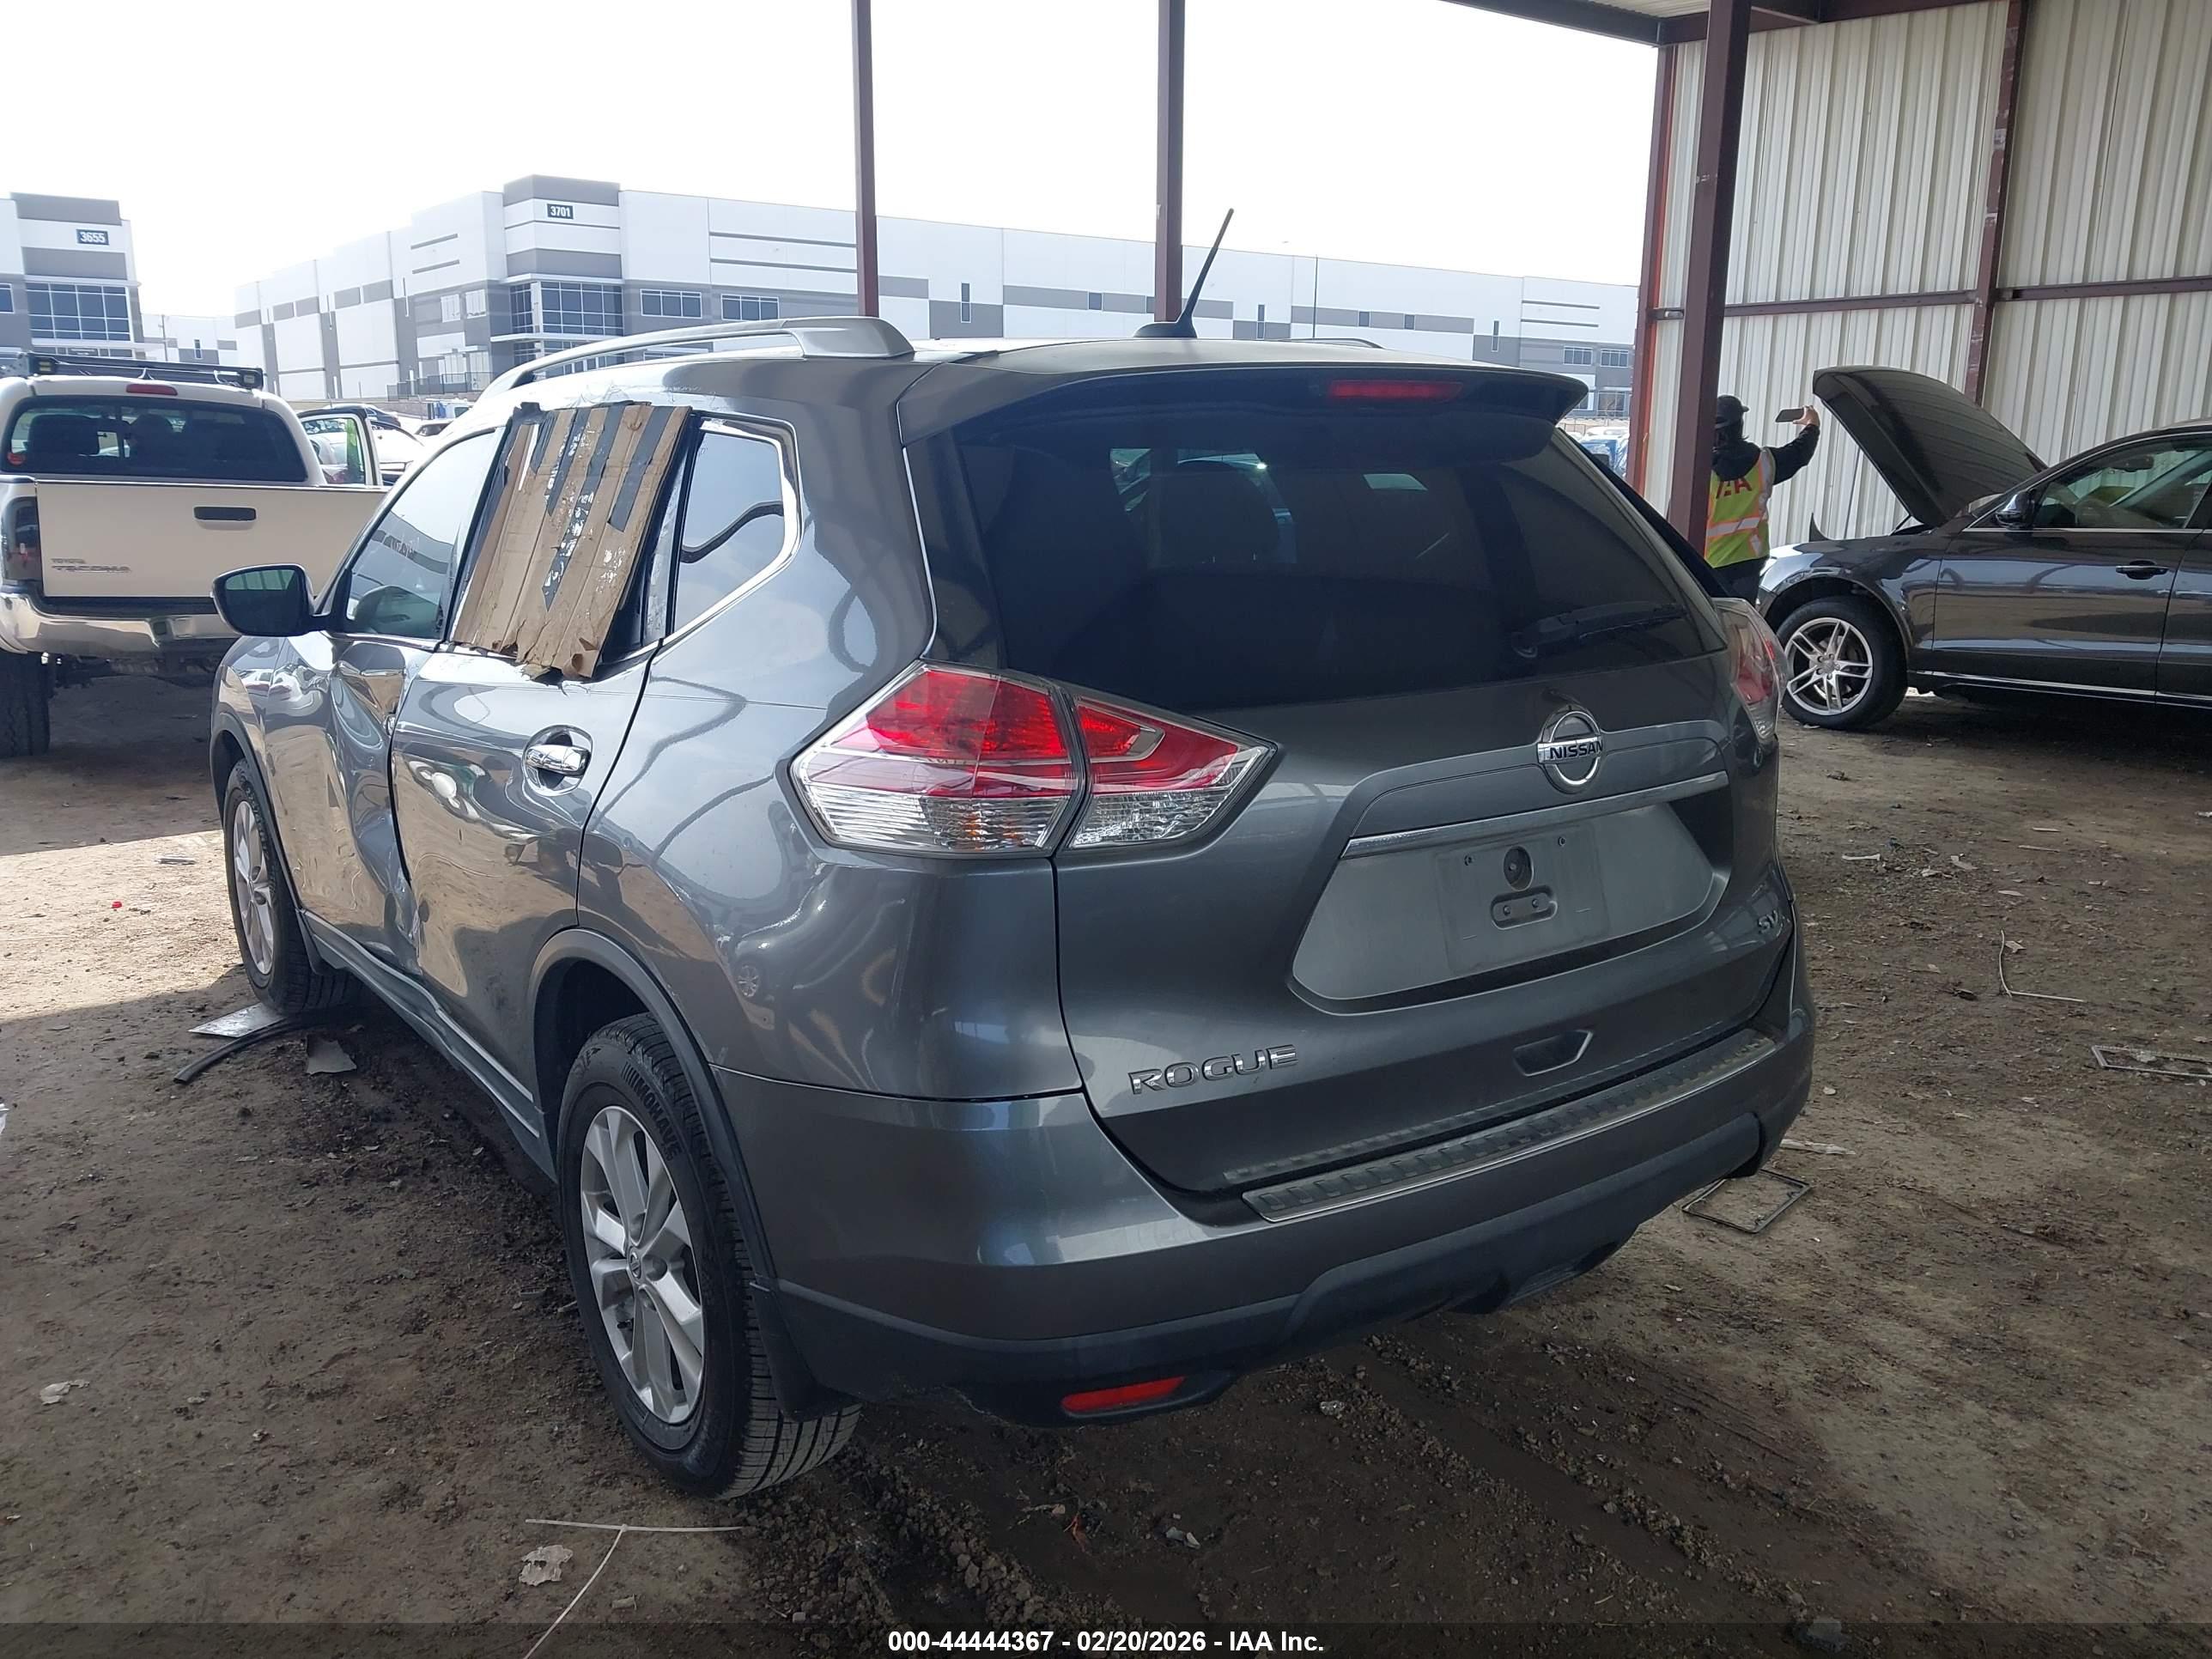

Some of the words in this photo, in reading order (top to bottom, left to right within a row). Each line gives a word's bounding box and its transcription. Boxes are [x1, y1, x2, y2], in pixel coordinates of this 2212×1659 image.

[550, 205, 571, 217] 3701
[80, 231, 105, 243] 3655
[1549, 740, 1603, 760] NISSAN
[1759, 910, 1778, 933] SV
[1127, 1044, 1298, 1095] ROGUE
[634, 1076, 683, 1154] MOHAVE
